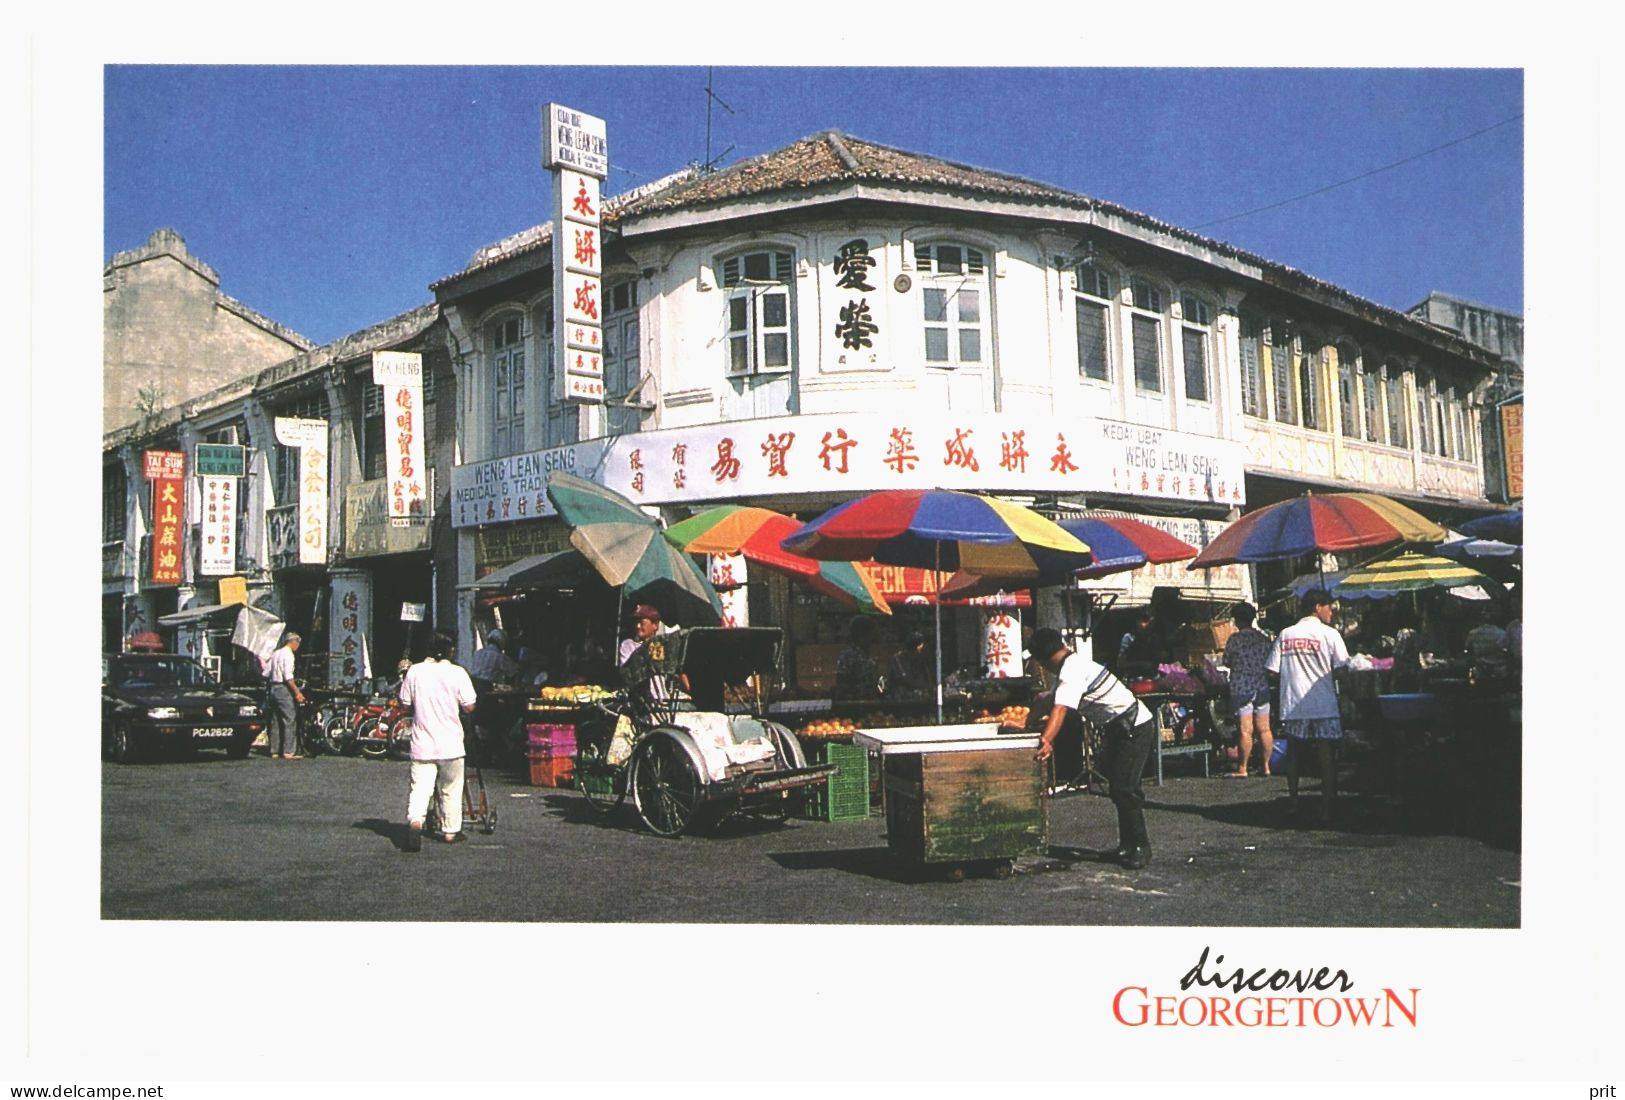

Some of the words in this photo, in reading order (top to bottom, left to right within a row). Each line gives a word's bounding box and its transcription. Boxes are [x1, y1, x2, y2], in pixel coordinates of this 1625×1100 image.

[575, 130, 591, 152] LEAN
[1137, 429, 1162, 445] UBAT
[148, 456, 161, 467] TAI
[165, 457, 183, 469] SUN
[475, 460, 505, 484] WENG
[510, 453, 540, 479] LEAN
[545, 448, 575, 473] SENG
[1126, 446, 1156, 469] WENG
[1162, 451, 1188, 473] LEAN
[1193, 455, 1219, 477] SENG
[456, 485, 497, 502] MEDICAL
[514, 474, 551, 494] TRADIN
